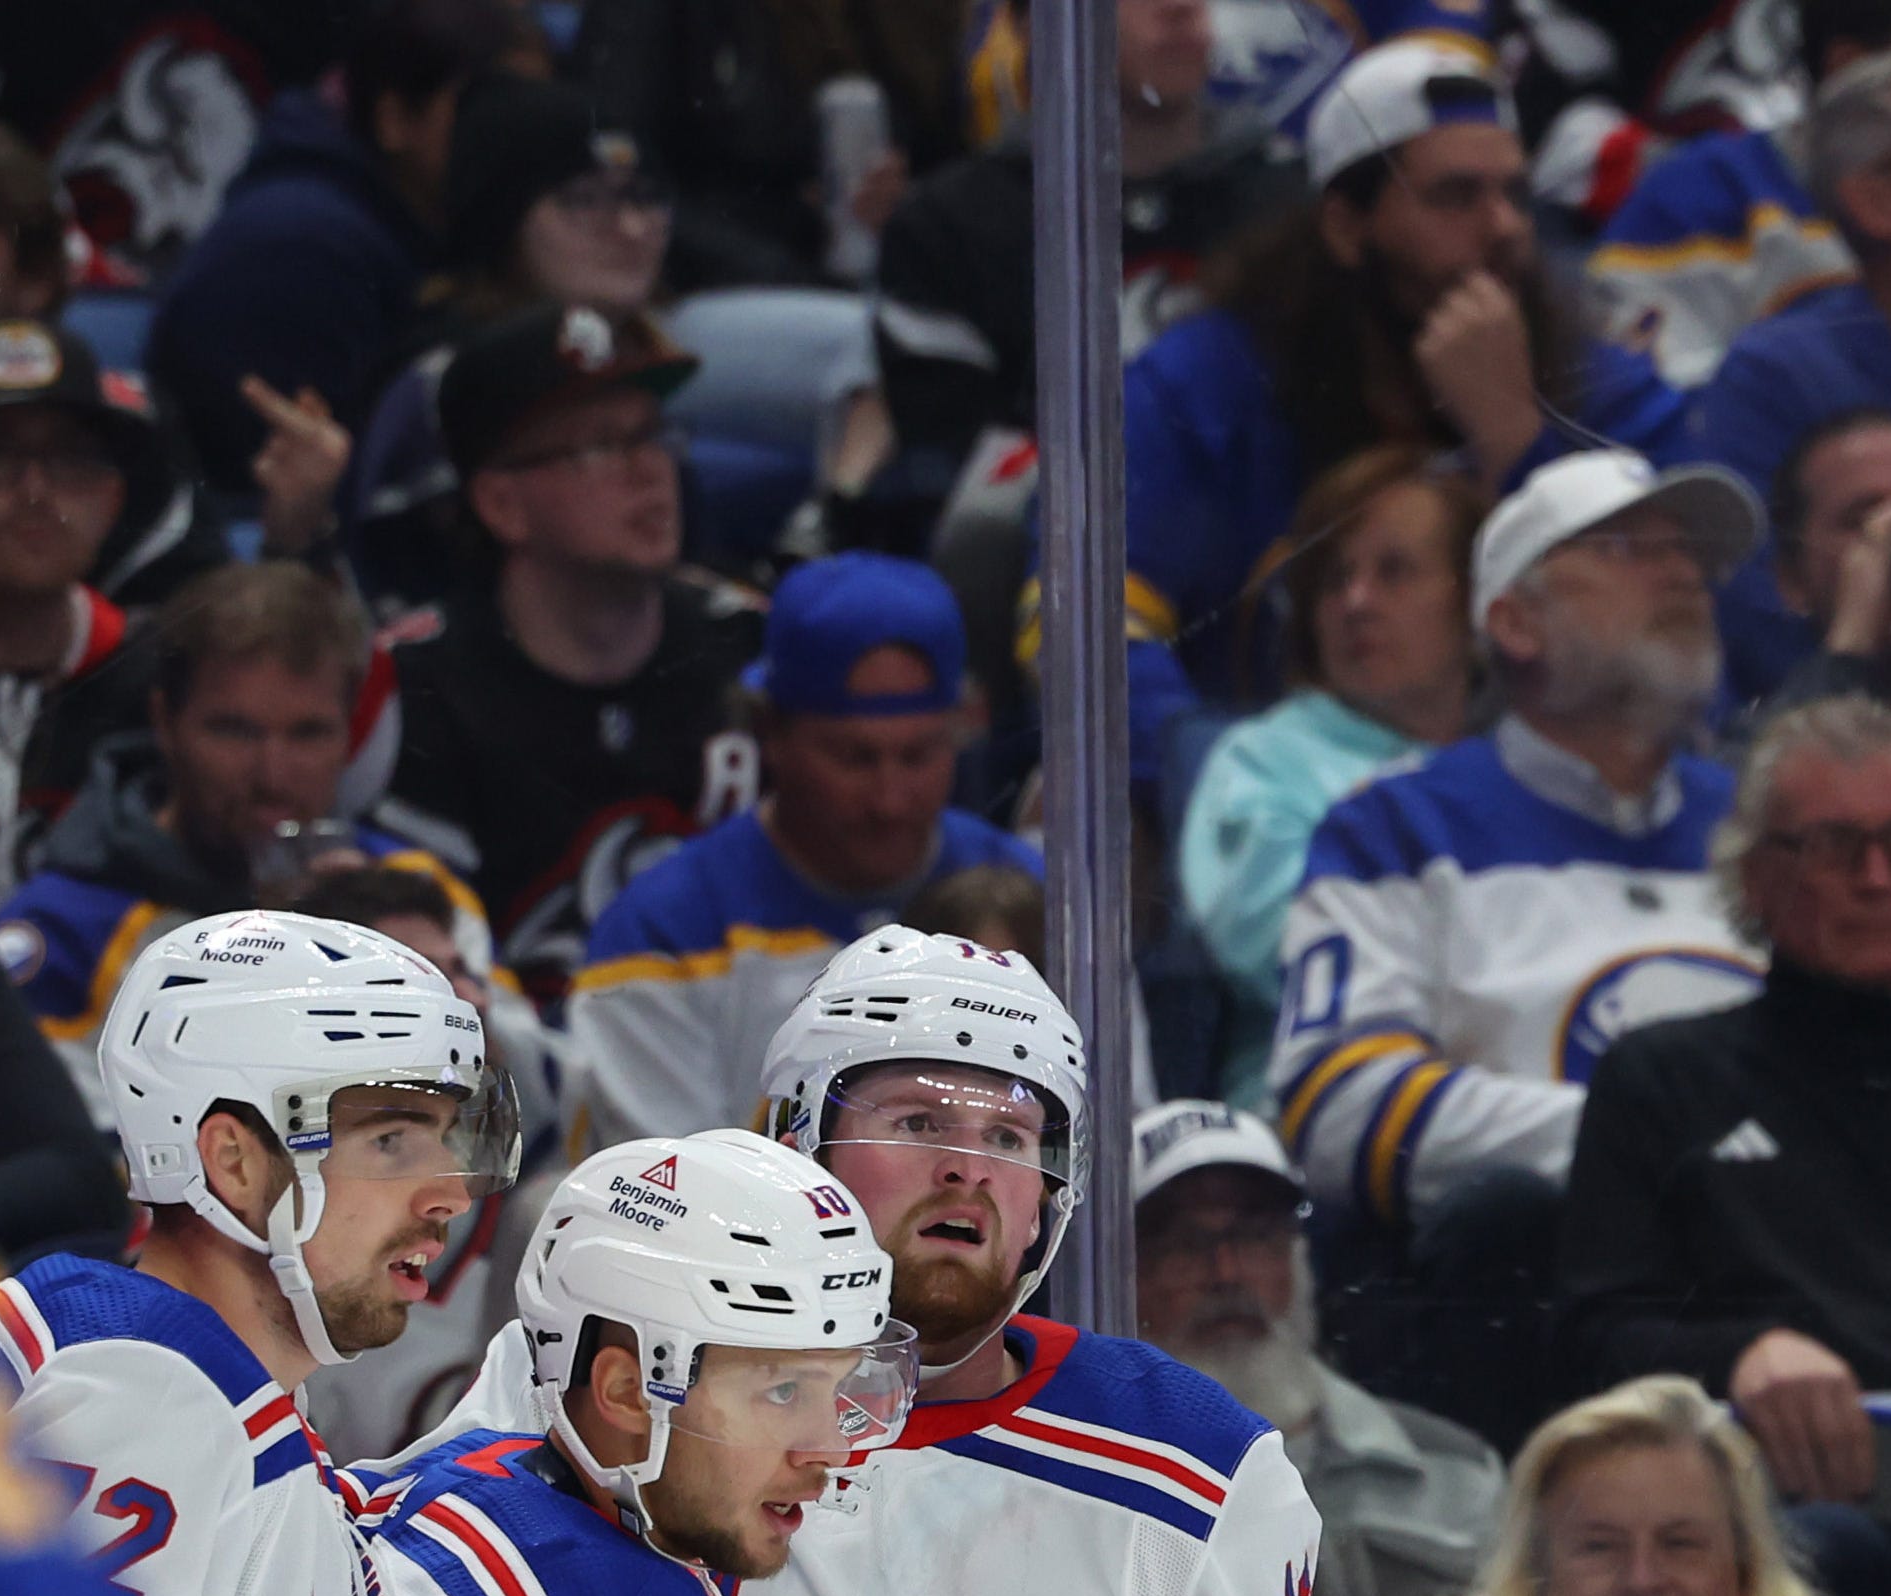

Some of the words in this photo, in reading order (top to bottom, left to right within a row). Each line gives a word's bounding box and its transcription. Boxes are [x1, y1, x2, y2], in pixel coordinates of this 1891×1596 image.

[195, 932, 287, 951] Bjamin
[200, 948, 265, 966] Moore
[609, 1175, 689, 1220] Benjamin
[608, 1197, 666, 1232] Moore
[821, 1267, 883, 1292] CCM
